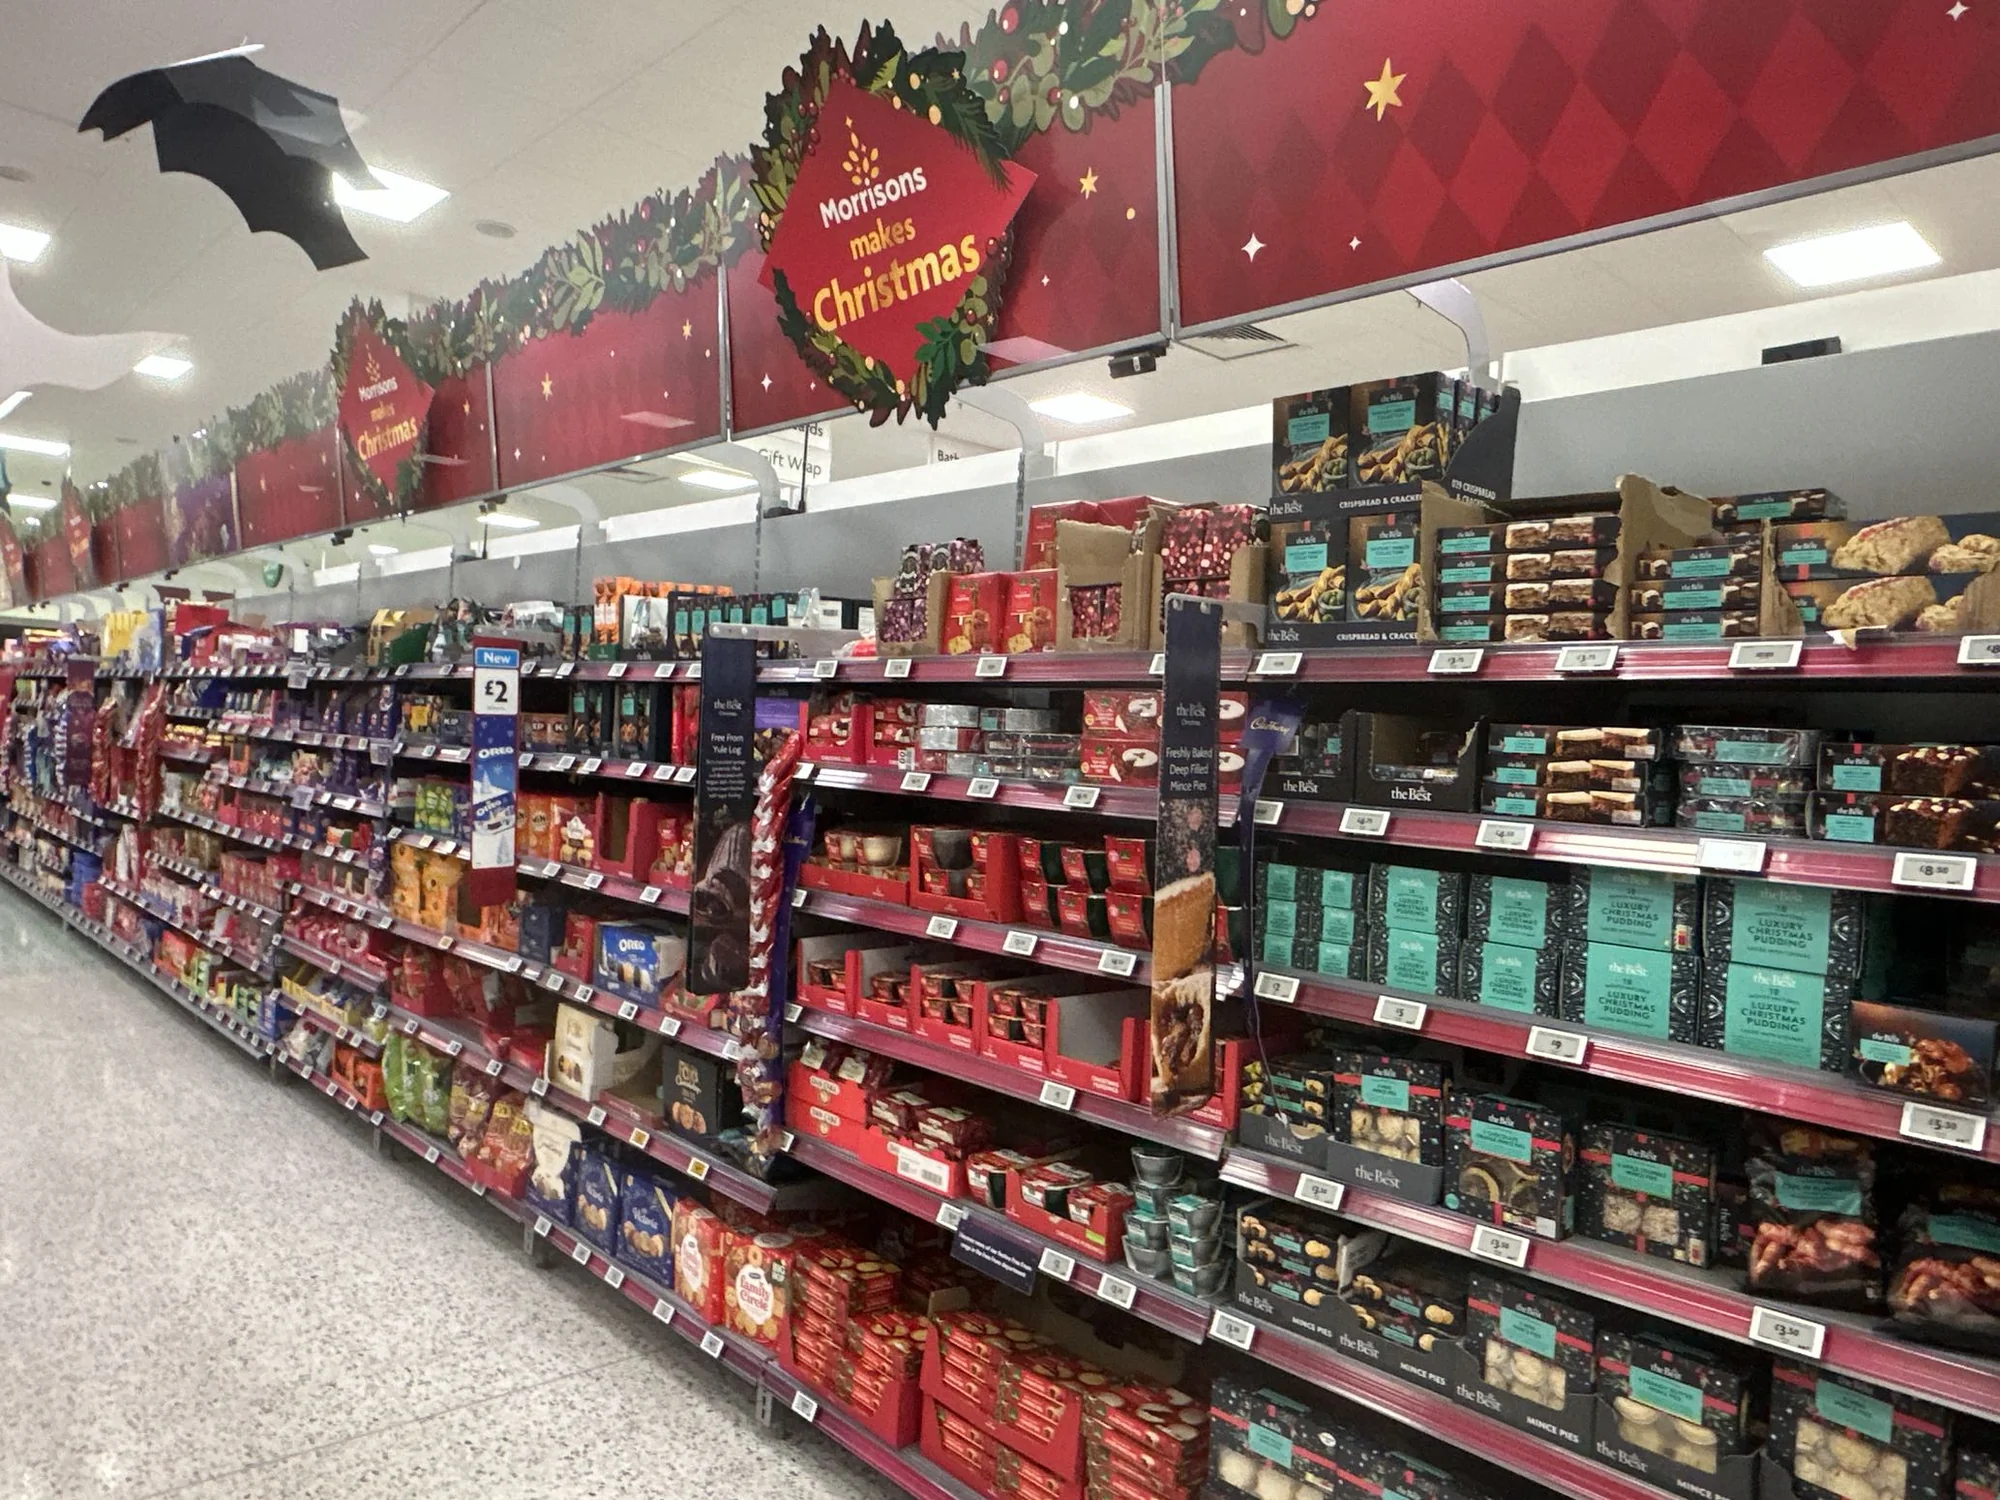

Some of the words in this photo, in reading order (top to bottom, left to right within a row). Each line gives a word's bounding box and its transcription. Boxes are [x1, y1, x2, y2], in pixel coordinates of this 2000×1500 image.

[819, 166, 927, 229] Morrisons
[849, 215, 916, 261] makes
[814, 234, 980, 332] Christmas
[359, 377, 398, 402] Morrisons
[370, 401, 395, 422] makes
[357, 416, 418, 461] Christmas
[788, 455, 821, 479] Wap
[1270, 501, 1285, 516] the
[1286, 499, 1303, 514] Best
[1339, 498, 1381, 509] CRISPBREAD
[1268, 628, 1280, 641] the
[1281, 628, 1299, 641] Best
[1337, 632, 1380, 641] CRISPBREAD
[484, 652, 511, 664] New
[485, 680, 508, 702] £2
[1176, 702, 1190, 716] the
[1190, 702, 1206, 717] Best
[1250, 716, 1290, 735] Cadbury
[711, 733, 725, 742] Free
[726, 733, 744, 742] From
[478, 747, 514, 759] OREO
[728, 746, 742, 756] Log
[1166, 747, 1190, 759] Freshly
[1192, 747, 1213, 758] Baked
[1169, 764, 1188, 775] Deep
[1190, 764, 1209, 774] Filled
[1170, 780, 1191, 791] Mince
[1193, 780, 1207, 790] Pies
[1283, 780, 1297, 791] the
[1298, 780, 1319, 793] Best
[1391, 787, 1408, 799] the
[1409, 786, 1432, 801] Best
[1602, 907, 1659, 921] CHRISTMAS
[1611, 902, 1650, 911] LUXURY
[1607, 917, 1652, 928] PUDDING
[1759, 919, 1804, 930] LUXURY
[1748, 926, 1813, 941] CHRISTMAS
[619, 939, 645, 952] OREO
[1754, 935, 1807, 948] PUDDING
[1608, 991, 1646, 1002] LUXURY
[1599, 997, 1655, 1013] CHRISTMAS
[1751, 1001, 1796, 1013] LUXURY
[1603, 1007, 1650, 1019] PUDDING
[1741, 1008, 1806, 1025] CHRISTMAS
[1747, 1018, 1798, 1032] PUDDING
[1264, 1133, 1279, 1148] the
[1281, 1137, 1304, 1155] Best
[1354, 1165, 1372, 1181] the
[1374, 1169, 1400, 1189] Best
[741, 1275, 770, 1299] Family
[740, 1290, 769, 1311] Circle
[1238, 1291, 1253, 1307] the
[1254, 1296, 1275, 1314] Best
[1292, 1316, 1315, 1332] MINCE
[1317, 1325, 1333, 1338] PIES
[1339, 1333, 1356, 1349] the
[1357, 1339, 1380, 1359] Best
[1400, 1362, 1427, 1379] MINCE
[1428, 1372, 1446, 1386] PIES
[1456, 1384, 1475, 1401] the
[1476, 1390, 1502, 1412] Best
[1526, 1416, 1557, 1435] MINCE
[1559, 1428, 1580, 1444] PIES
[1596, 1440, 1617, 1460] the
[1618, 1450, 1650, 1475] Best
